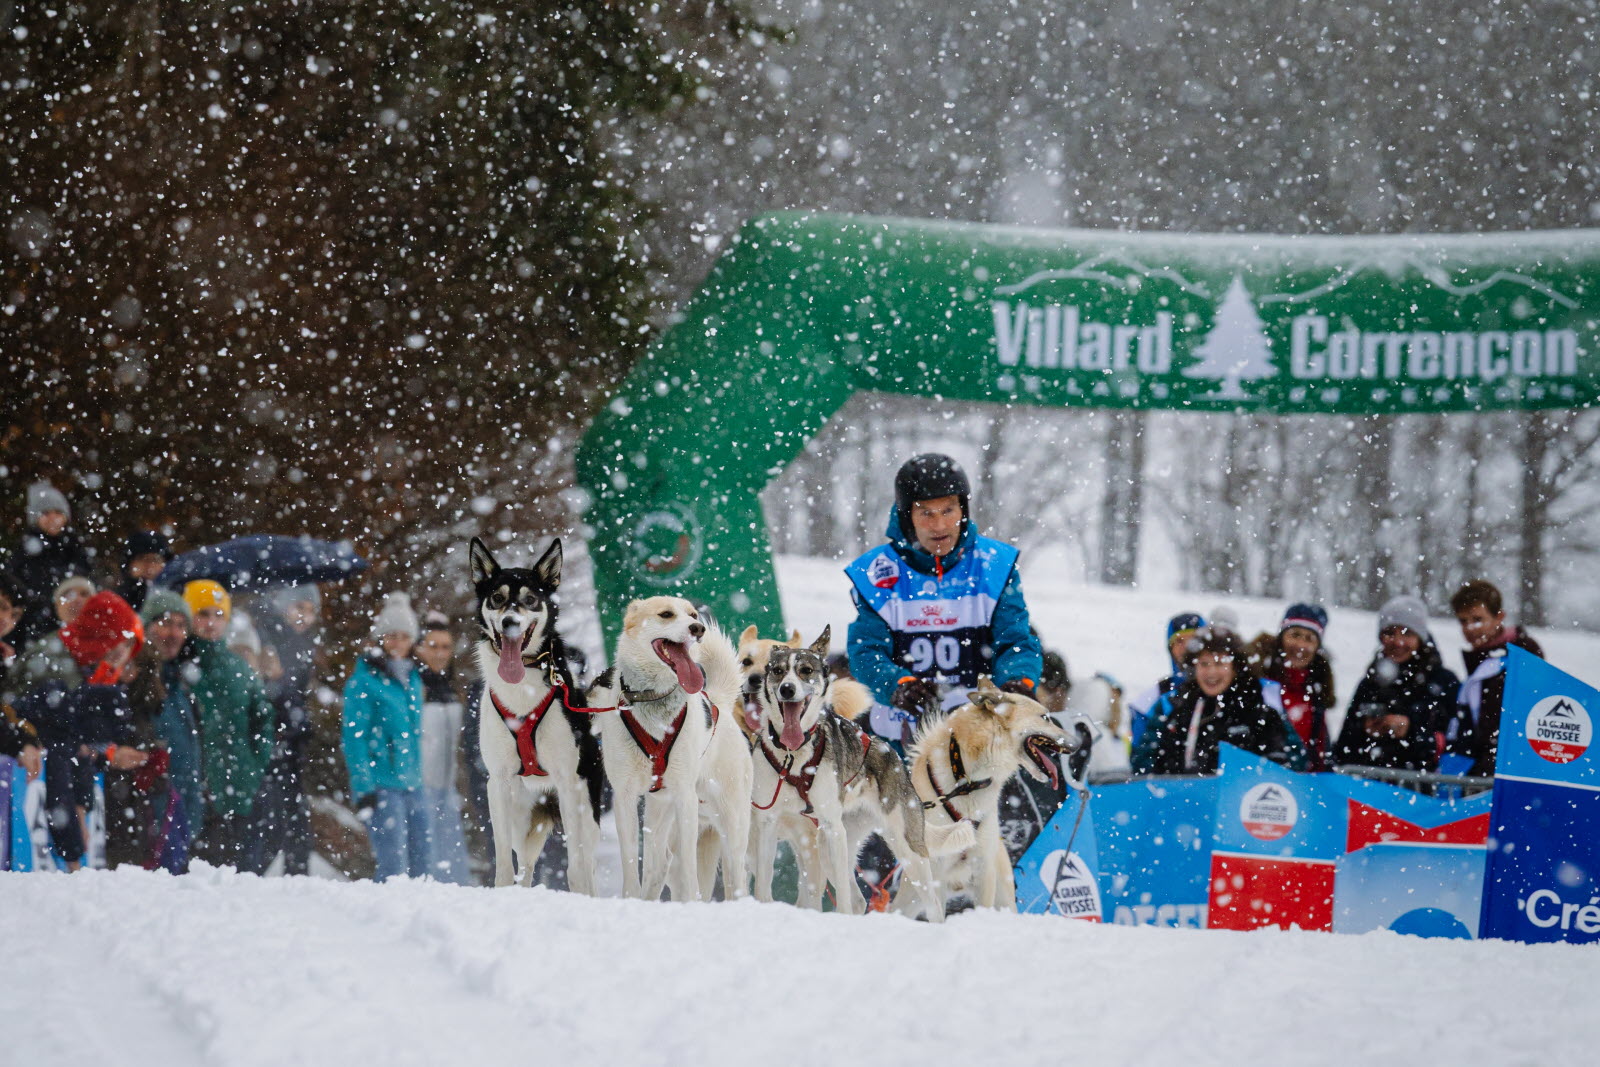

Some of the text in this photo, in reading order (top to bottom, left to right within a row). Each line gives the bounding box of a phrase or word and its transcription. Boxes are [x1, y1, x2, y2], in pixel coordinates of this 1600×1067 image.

[992, 300, 1577, 382] Villard Corrençon
[910, 636, 960, 672] 90
[1549, 720, 1581, 732] GRANDE
